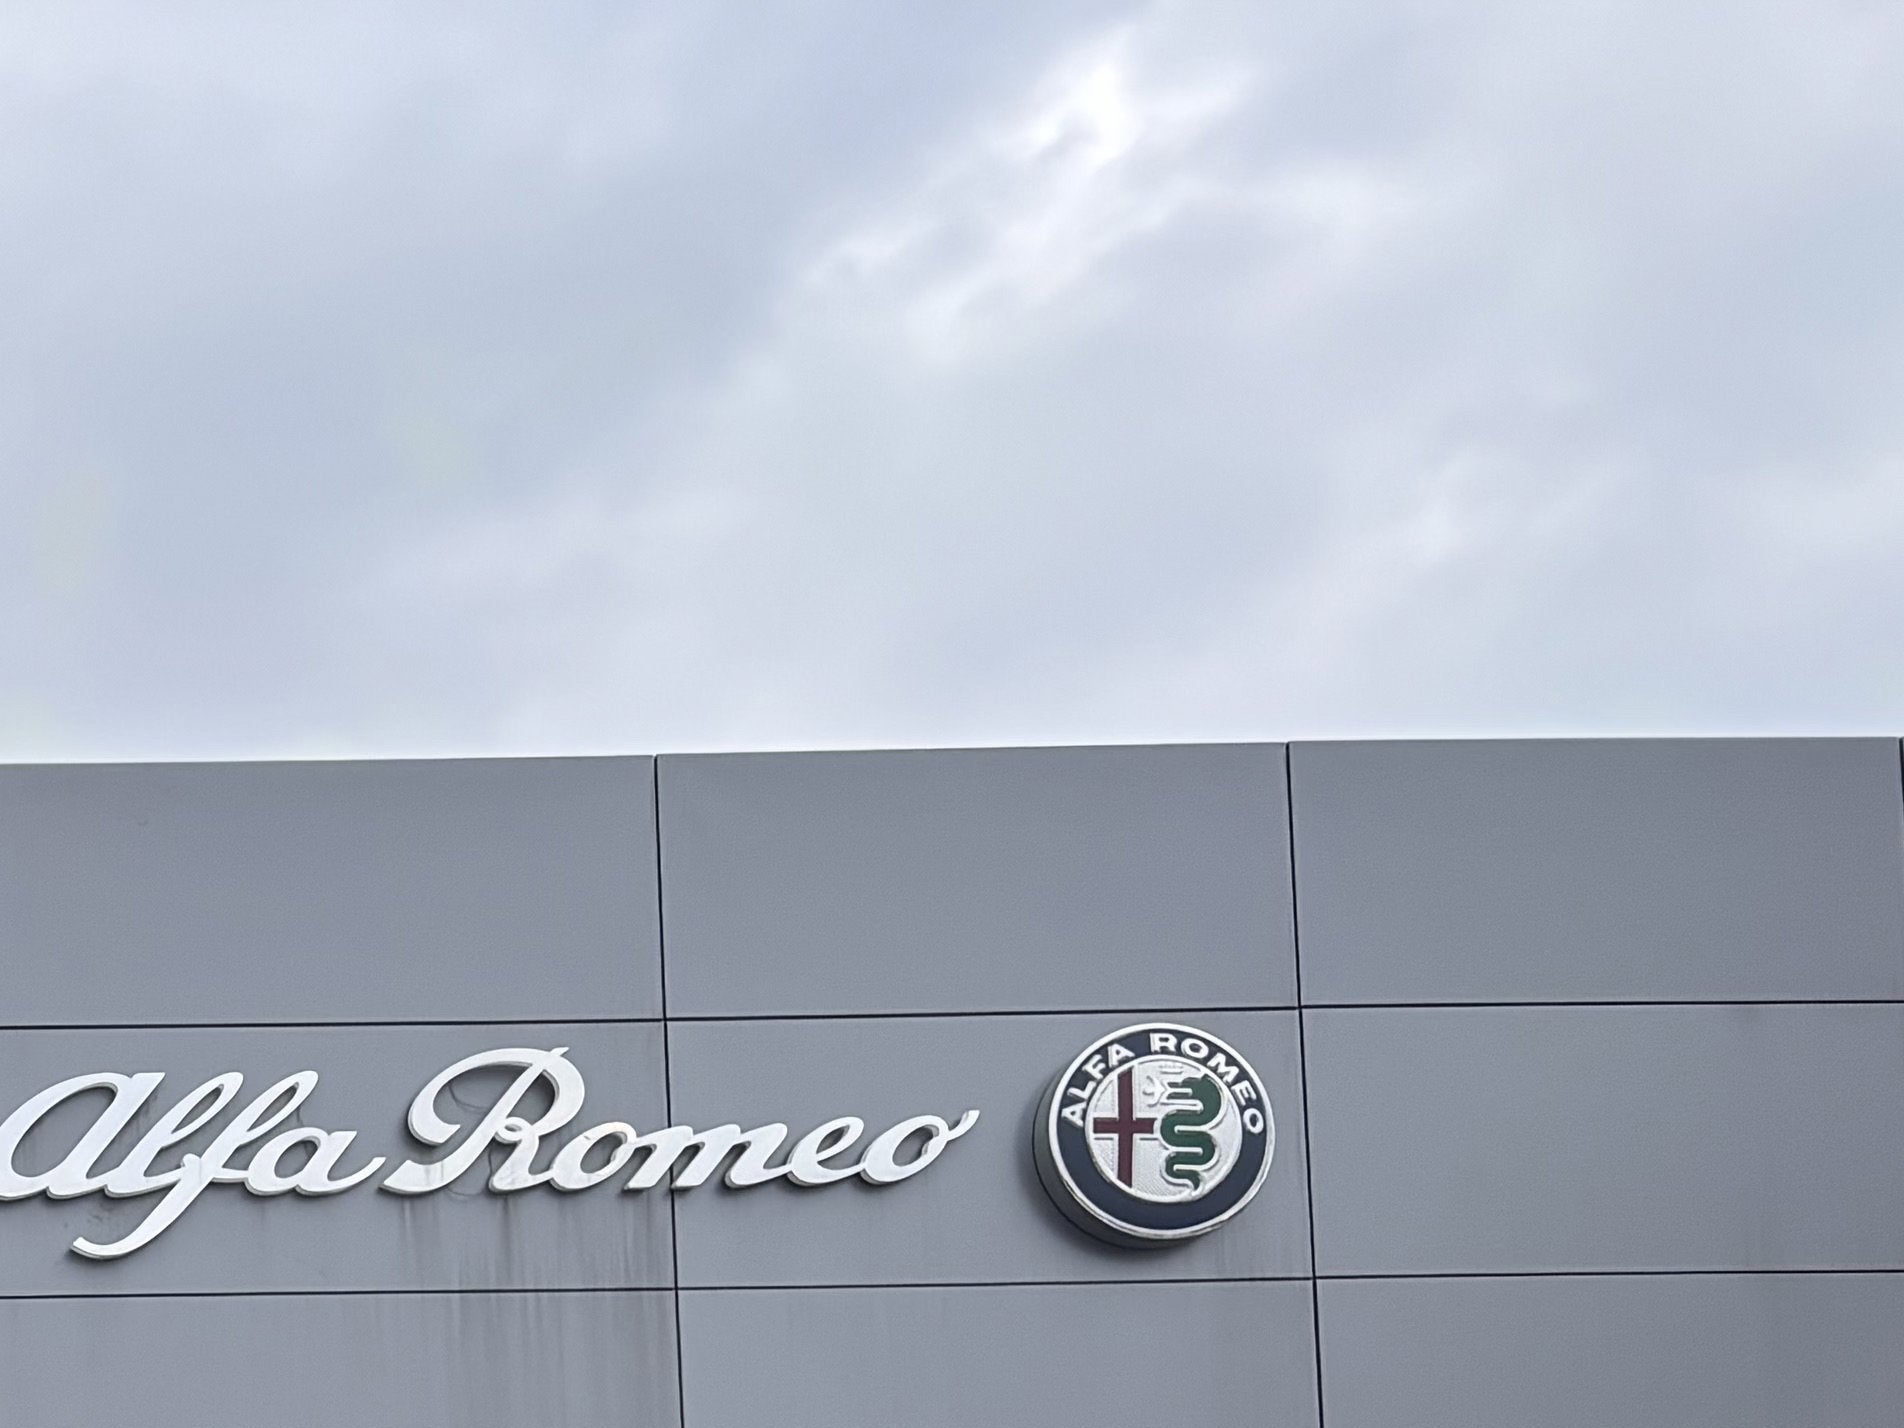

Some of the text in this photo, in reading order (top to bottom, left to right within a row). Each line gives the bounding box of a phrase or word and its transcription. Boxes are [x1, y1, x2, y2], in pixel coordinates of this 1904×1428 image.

[379, 1046, 980, 1196] Romeo
[1061, 1033, 1264, 1135] ALFA ROMEO
